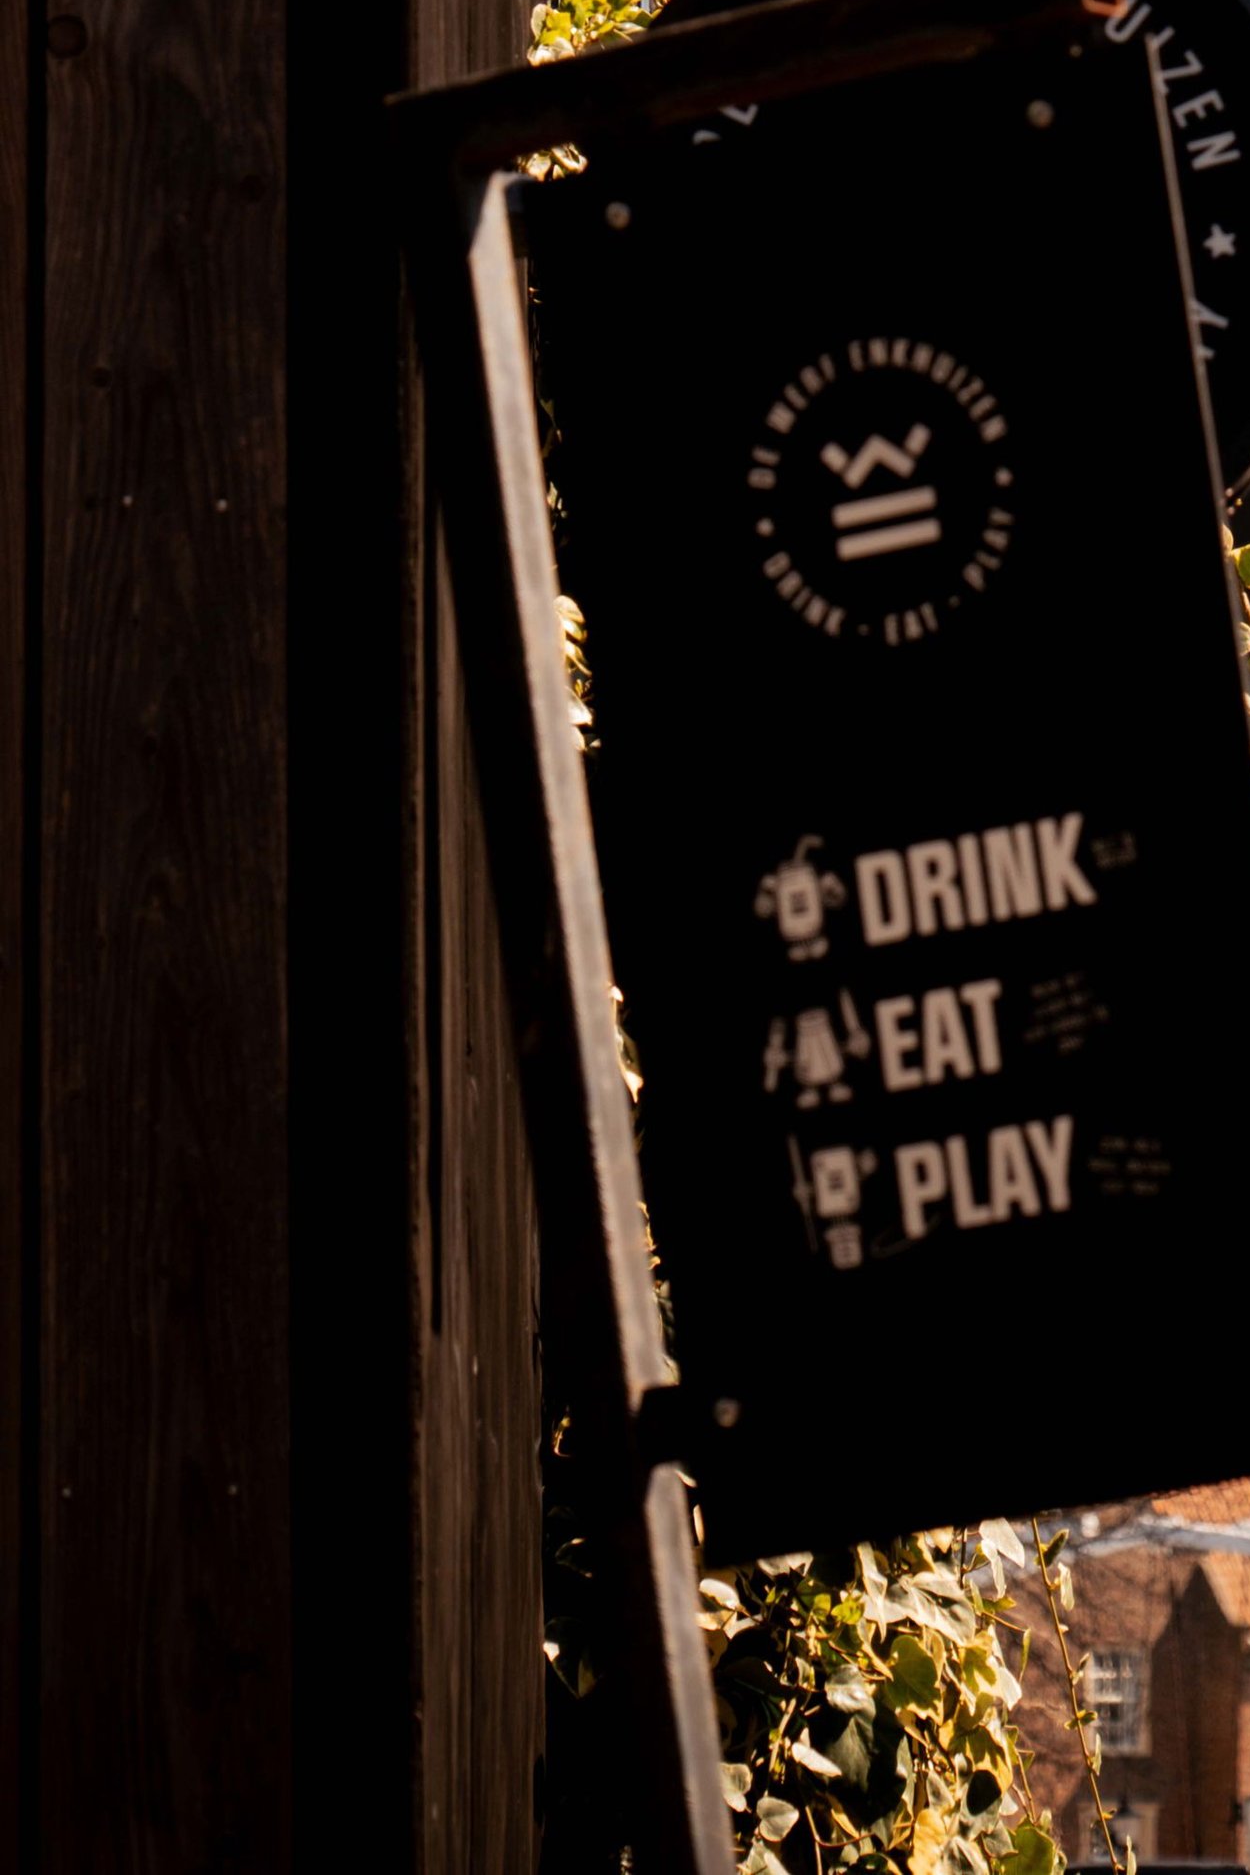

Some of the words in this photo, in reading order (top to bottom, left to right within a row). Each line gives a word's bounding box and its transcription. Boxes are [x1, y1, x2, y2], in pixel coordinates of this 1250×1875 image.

[855, 812, 1096, 946] DRINK
[875, 978, 1002, 1092] EAT
[895, 1114, 1073, 1240] PLAY
